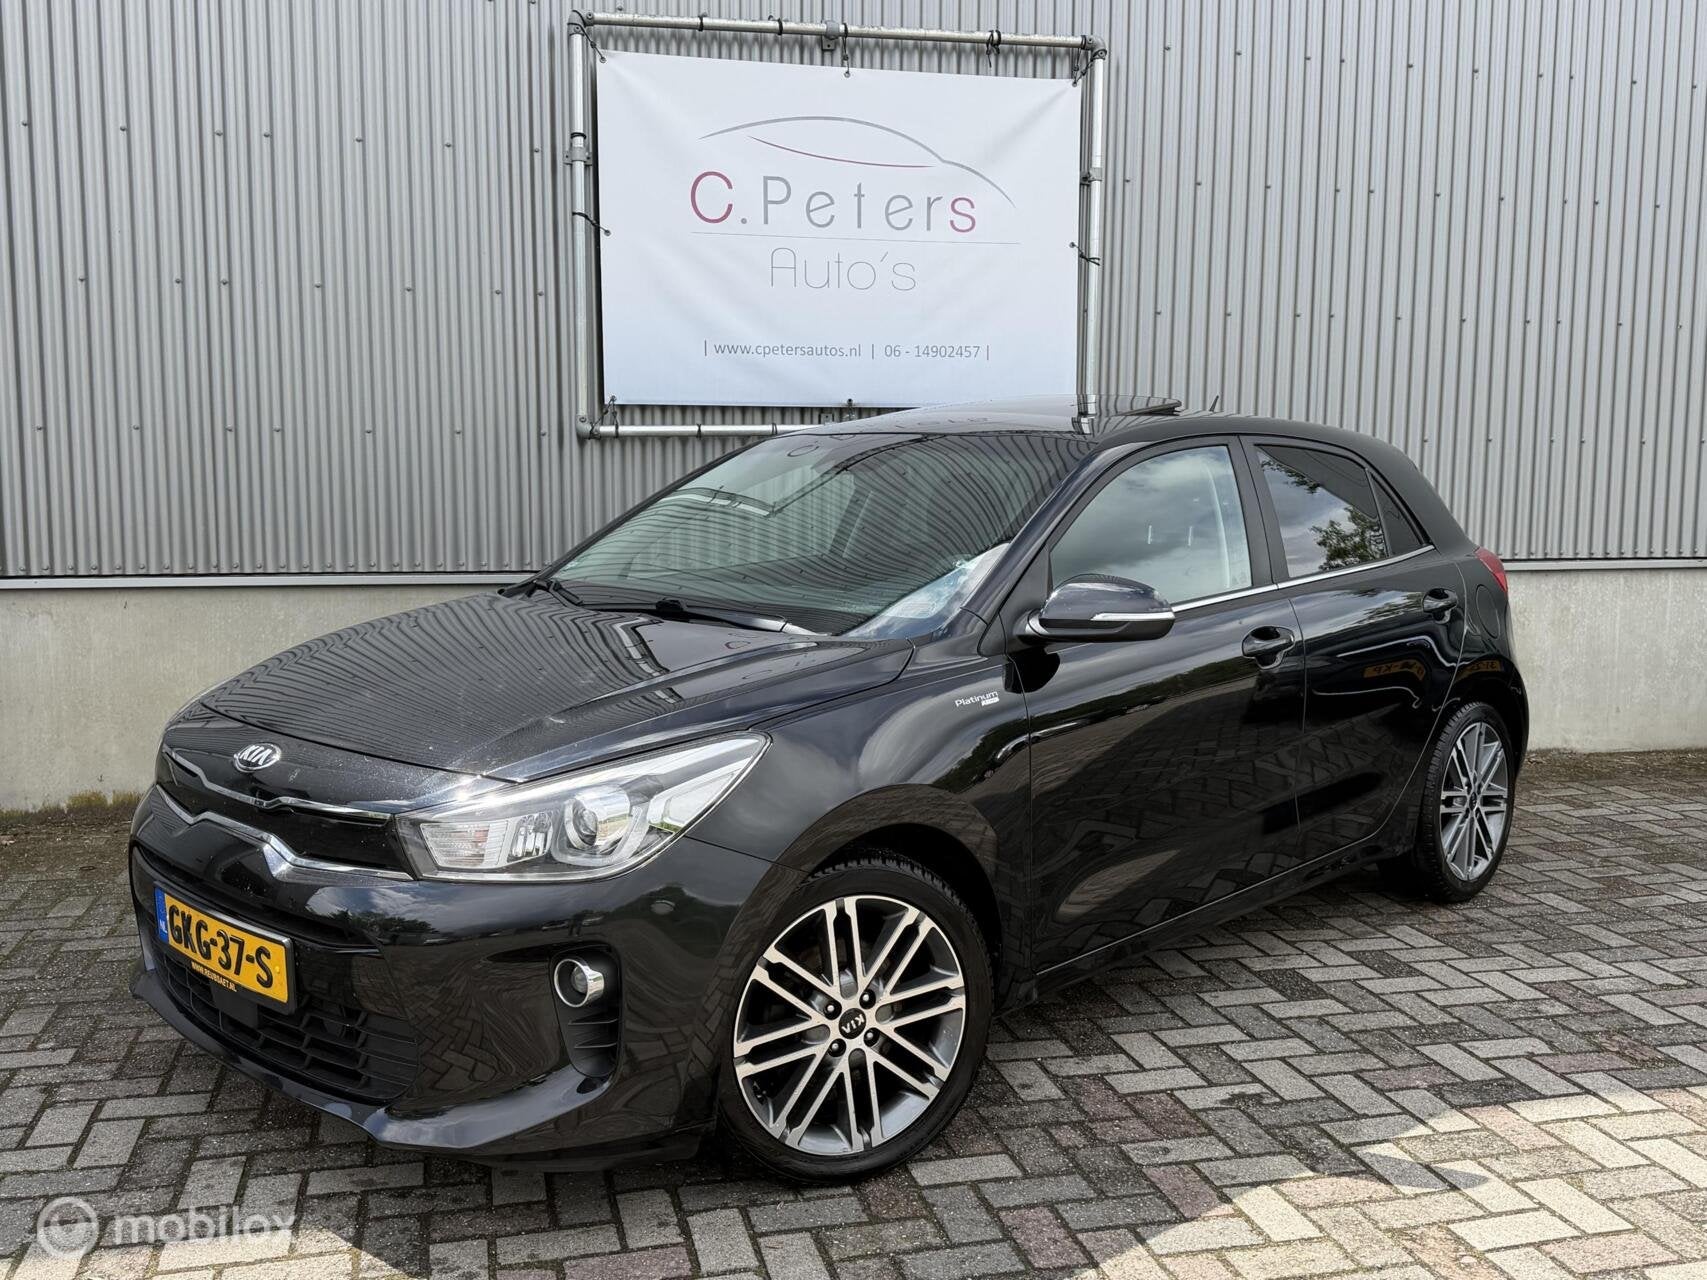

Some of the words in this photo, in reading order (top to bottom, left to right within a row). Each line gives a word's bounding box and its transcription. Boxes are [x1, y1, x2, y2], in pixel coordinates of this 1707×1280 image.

[713, 341, 861, 358] www.cpetersautos.nl
[884, 344, 901, 358] 06
[914, 344, 980, 359] 14902457
[955, 691, 998, 707] Platinum
[239, 745, 272, 766] KIA
[168, 904, 273, 988] GKG-37-S
[841, 1013, 865, 1033] KIA
